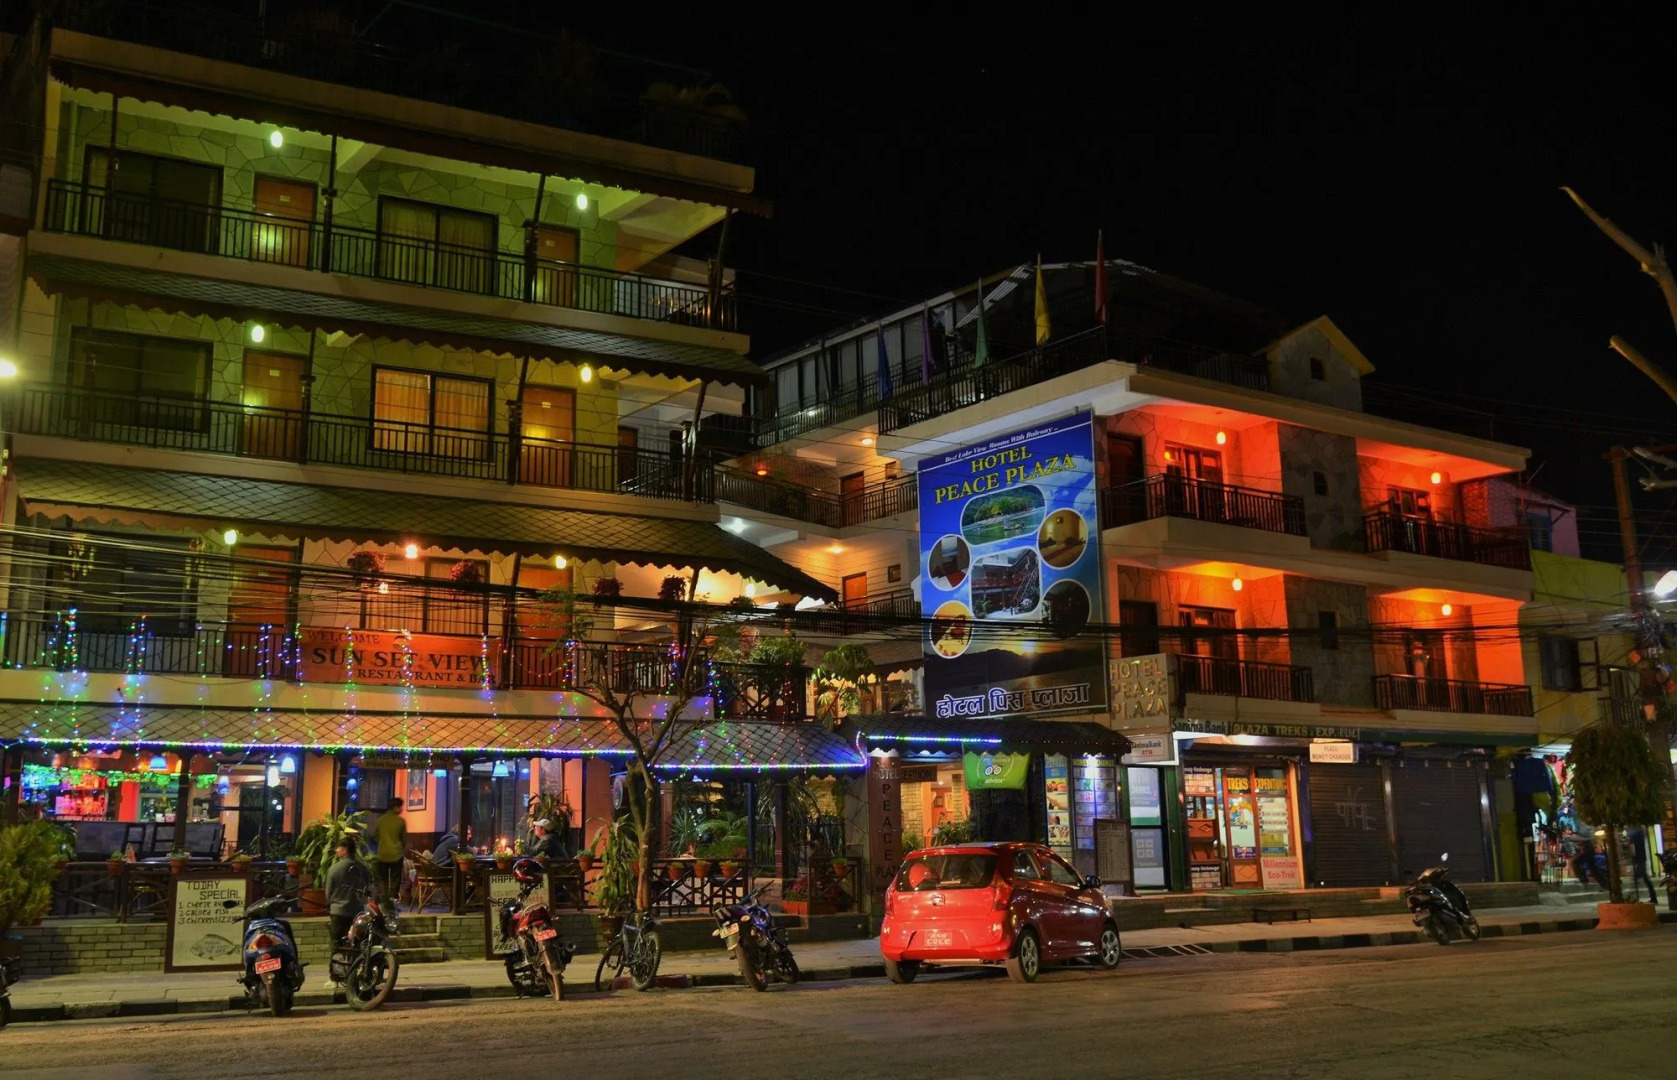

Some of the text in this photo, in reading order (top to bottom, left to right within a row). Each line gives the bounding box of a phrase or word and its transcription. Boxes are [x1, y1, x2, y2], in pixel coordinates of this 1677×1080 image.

[971, 446, 1032, 473] HOTEL
[935, 453, 1076, 504] PEACE PLAZA
[309, 630, 380, 645] WELCOME
[312, 648, 491, 671] SUN SET VIEW
[1110, 658, 1163, 679] HOTEL
[457, 674, 467, 683] &
[1112, 677, 1167, 699] PEACE
[936, 694, 986, 719] होटल
[1030, 683, 1090, 708] प्लाजा
[1112, 697, 1168, 719] PLAZA
[1171, 719, 1203, 733] Sanima
[1206, 720, 1227, 734] Bank
[1233, 723, 1269, 735] PLAZA
[1274, 725, 1308, 737] TREKS
[873, 768, 899, 780] HOTEL
[1227, 777, 1249, 791] TREKS
[491, 875, 517, 884] HAPP
[876, 867, 899, 879] PLAZ
[184, 881, 220, 890] TODAY
[200, 889, 241, 901] SPECIAL
